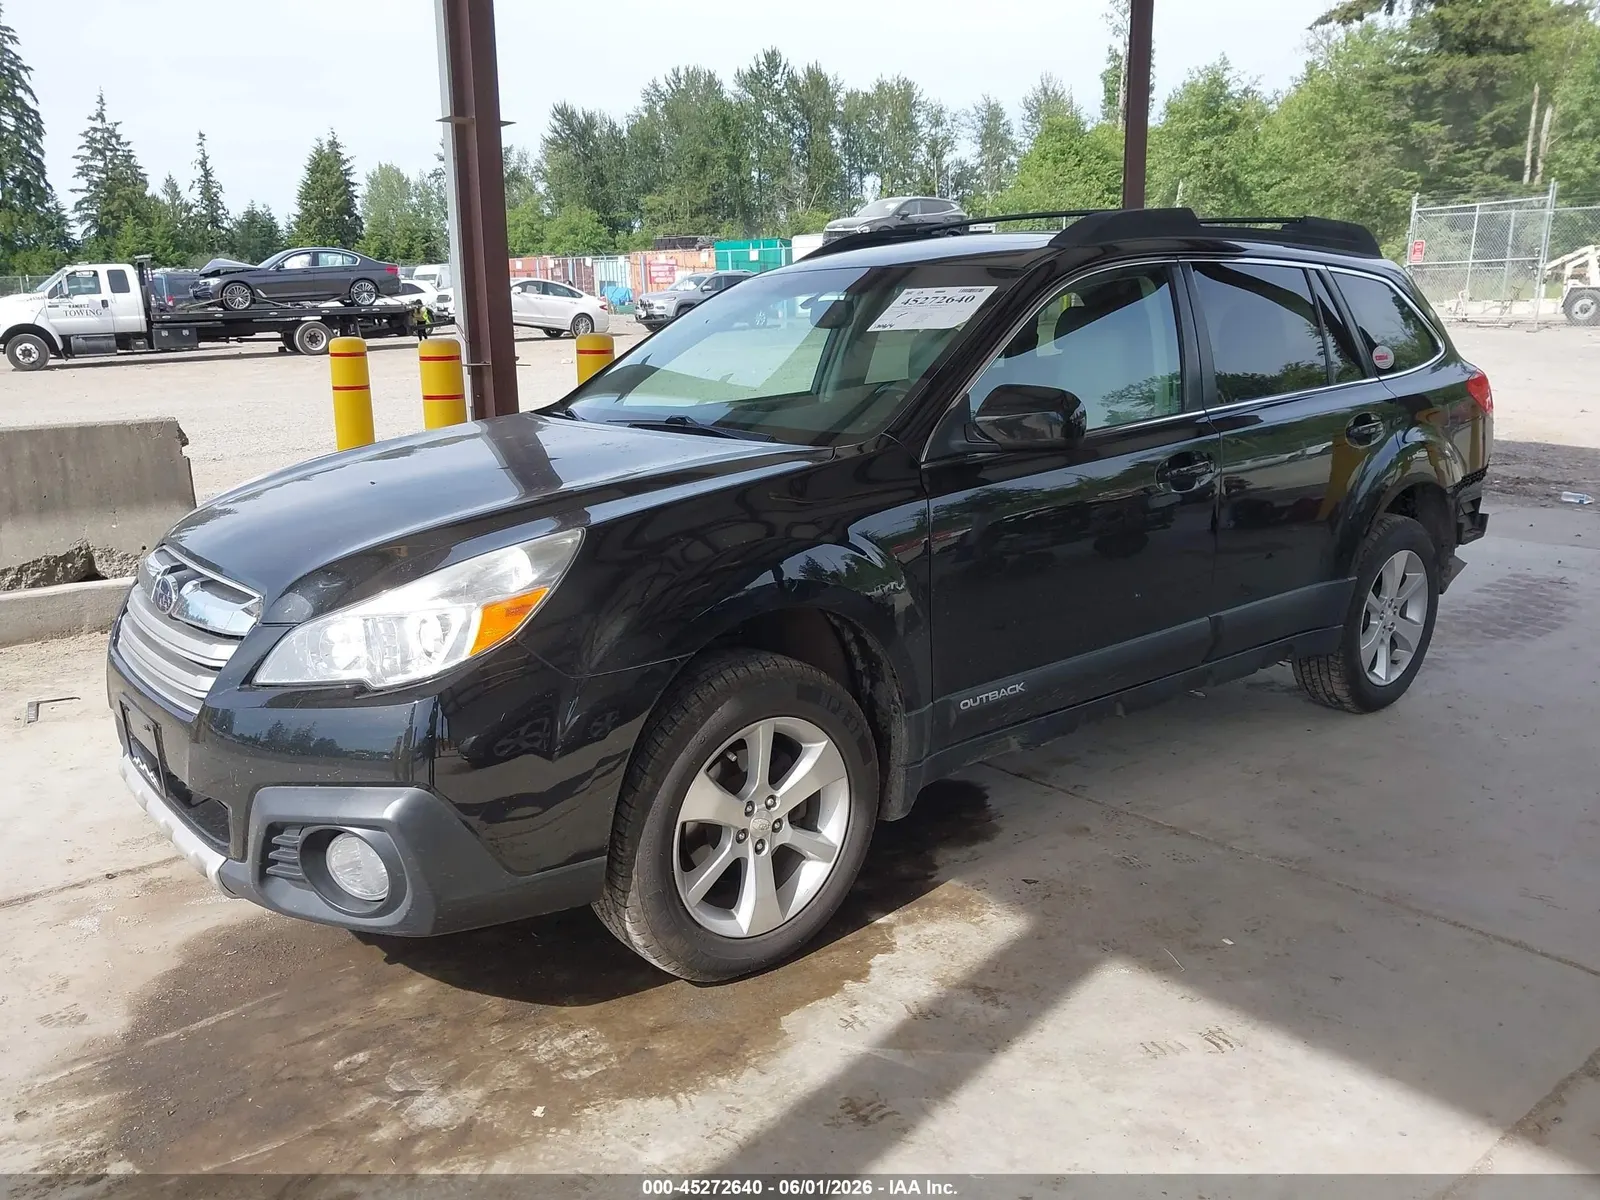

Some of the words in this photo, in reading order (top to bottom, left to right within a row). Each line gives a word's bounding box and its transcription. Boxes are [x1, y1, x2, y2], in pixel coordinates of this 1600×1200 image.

[901, 295, 976, 306] 45272640
[63, 308, 103, 317] TOWING
[960, 681, 1026, 710] OUTBACK
